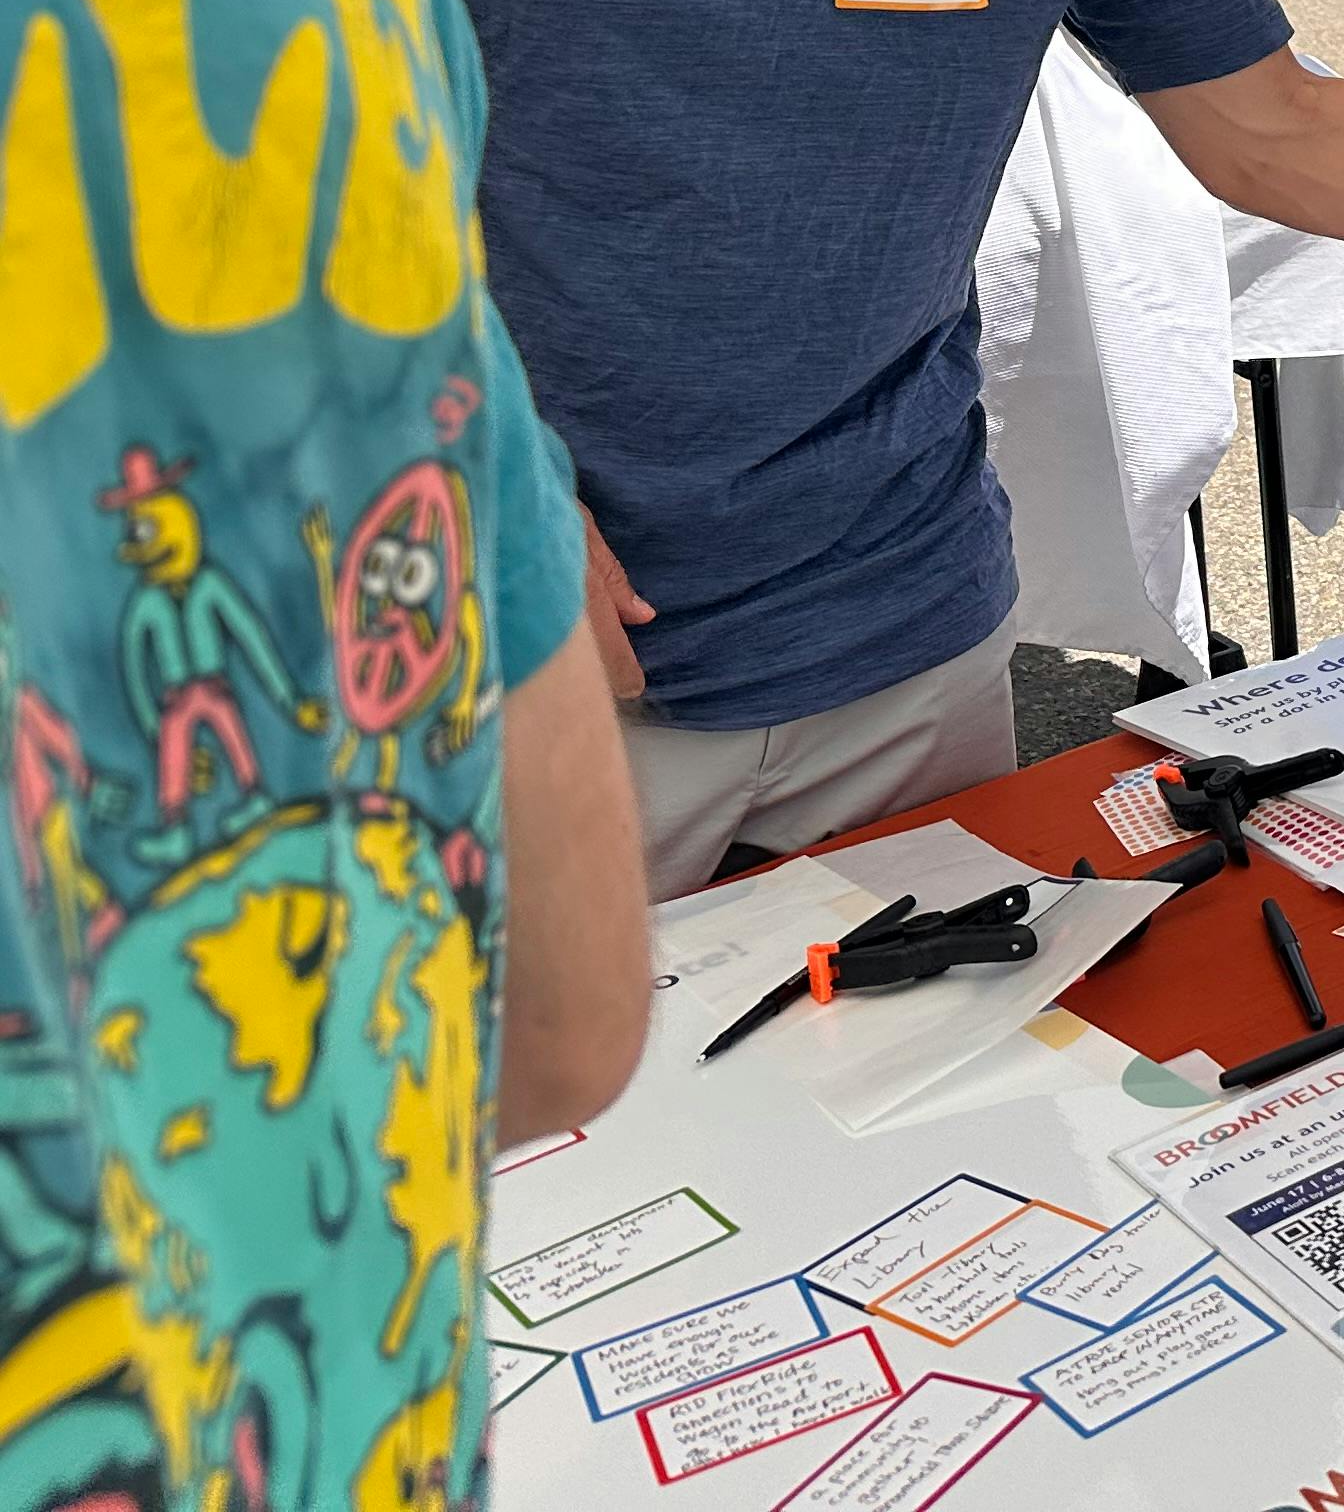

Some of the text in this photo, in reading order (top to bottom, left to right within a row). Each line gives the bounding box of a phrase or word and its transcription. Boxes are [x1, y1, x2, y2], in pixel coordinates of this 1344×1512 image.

[1182, 671, 1310, 717] Where
[1214, 705, 1266, 728] Show
[1272, 695, 1294, 708] us
[1297, 686, 1322, 700] by
[1233, 722, 1254, 735] or
[1261, 716, 1274, 725] a
[1278, 702, 1312, 718] dot
[1316, 692, 1336, 704] in
[1188, 1162, 1236, 1190] Join
[1240, 1146, 1266, 1163] us
[1272, 1133, 1295, 1149] at
[1300, 1120, 1327, 1137] an
[1264, 1163, 1305, 1183] Scan
[1307, 1143, 1344, 1166] each
[1288, 1144, 1310, 1159] All
[907, 1196, 953, 1224] the
[1250, 1196, 1286, 1217] June
[1287, 1184, 1306, 1199] 17
[598, 1332, 655, 1362] MAKE
[667, 1321, 734, 1351] enough
[727, 1322, 767, 1344] our
[669, 1395, 707, 1419] RTD
[756, 1388, 809, 1417] Road
